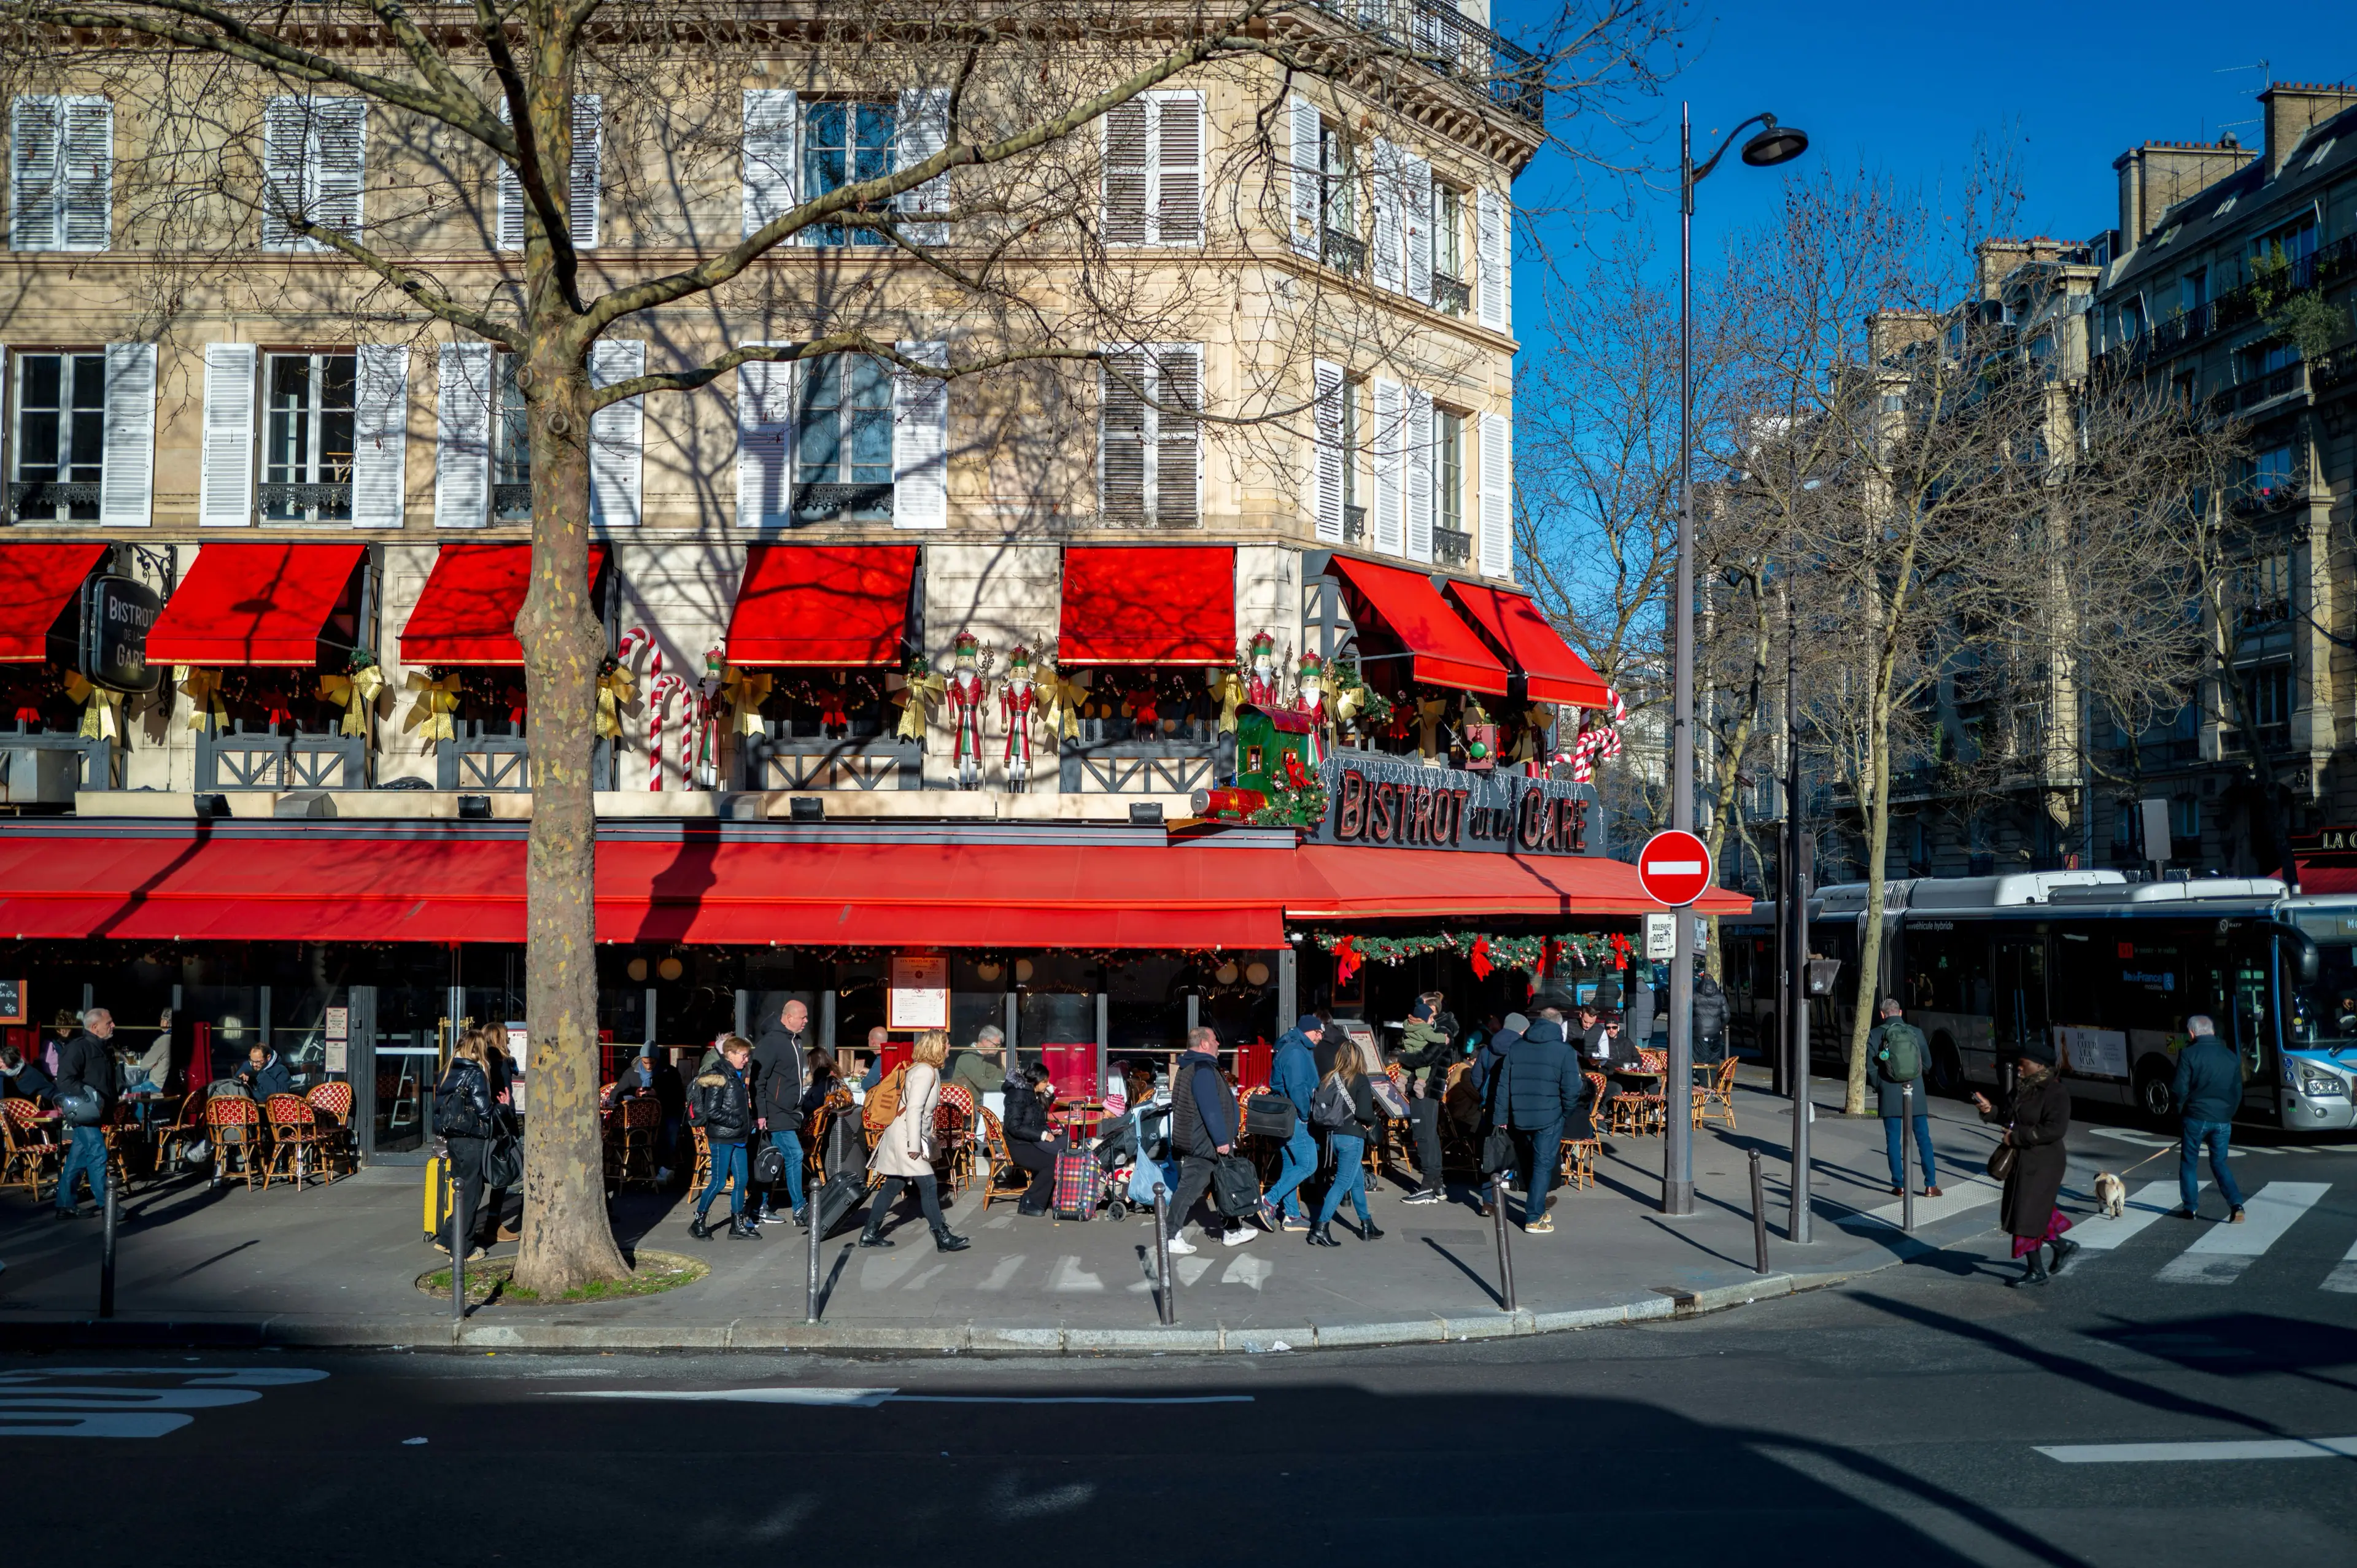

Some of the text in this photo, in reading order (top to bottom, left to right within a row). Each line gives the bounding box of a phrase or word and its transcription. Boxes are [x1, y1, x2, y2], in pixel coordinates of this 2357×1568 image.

[109, 595, 155, 629] BISTROT
[123, 628, 132, 641] DE
[116, 643, 145, 672] GARE
[1336, 768, 1590, 852] BISTROT DE LA GARE
[2323, 832, 2344, 850] LA
[1913, 921, 1954, 932] véhicule hybride
